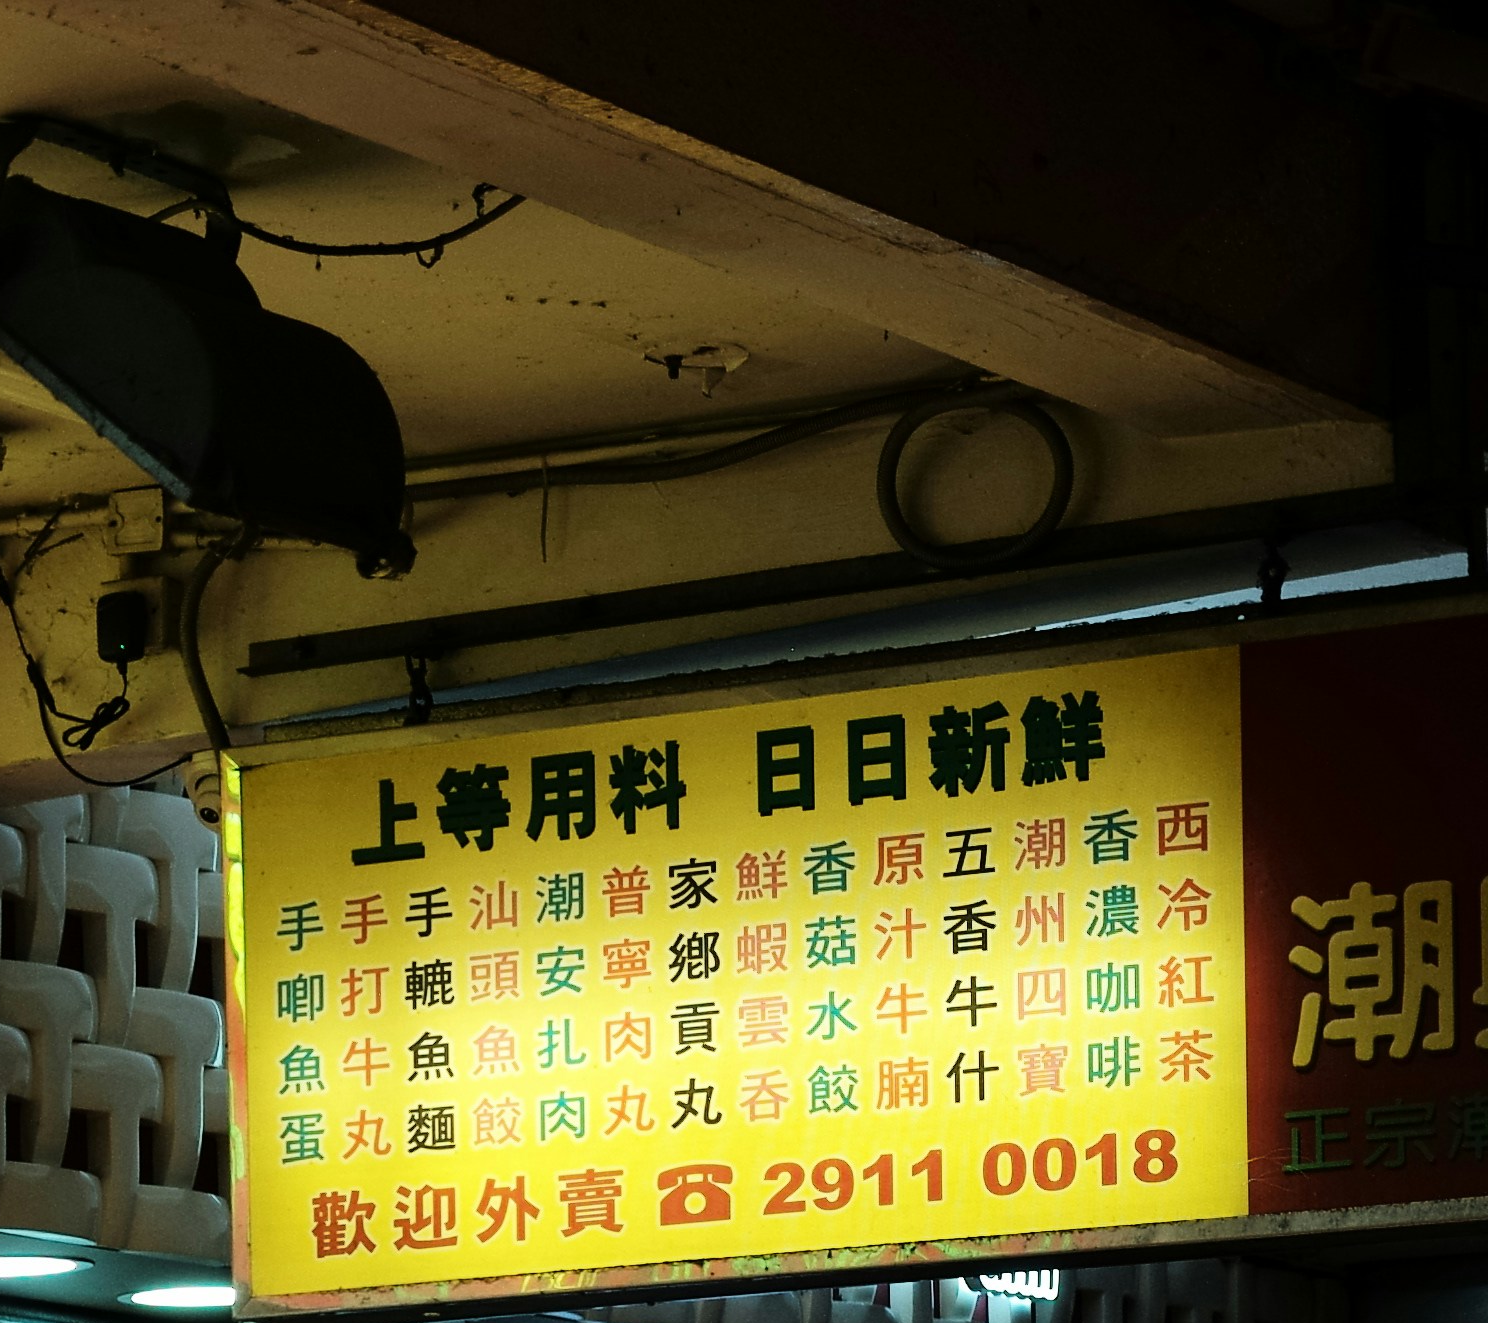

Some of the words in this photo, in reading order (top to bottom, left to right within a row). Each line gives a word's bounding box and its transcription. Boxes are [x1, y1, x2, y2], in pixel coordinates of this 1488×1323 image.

[350, 739, 687, 866] 上等用料
[755, 690, 1106, 817] 日日新鮮
[1288, 878, 1488, 1070] 潮
[310, 1166, 627, 1261] 歡迎外賣
[763, 1144, 944, 1217] 2911
[983, 1127, 1181, 1198] 0018
